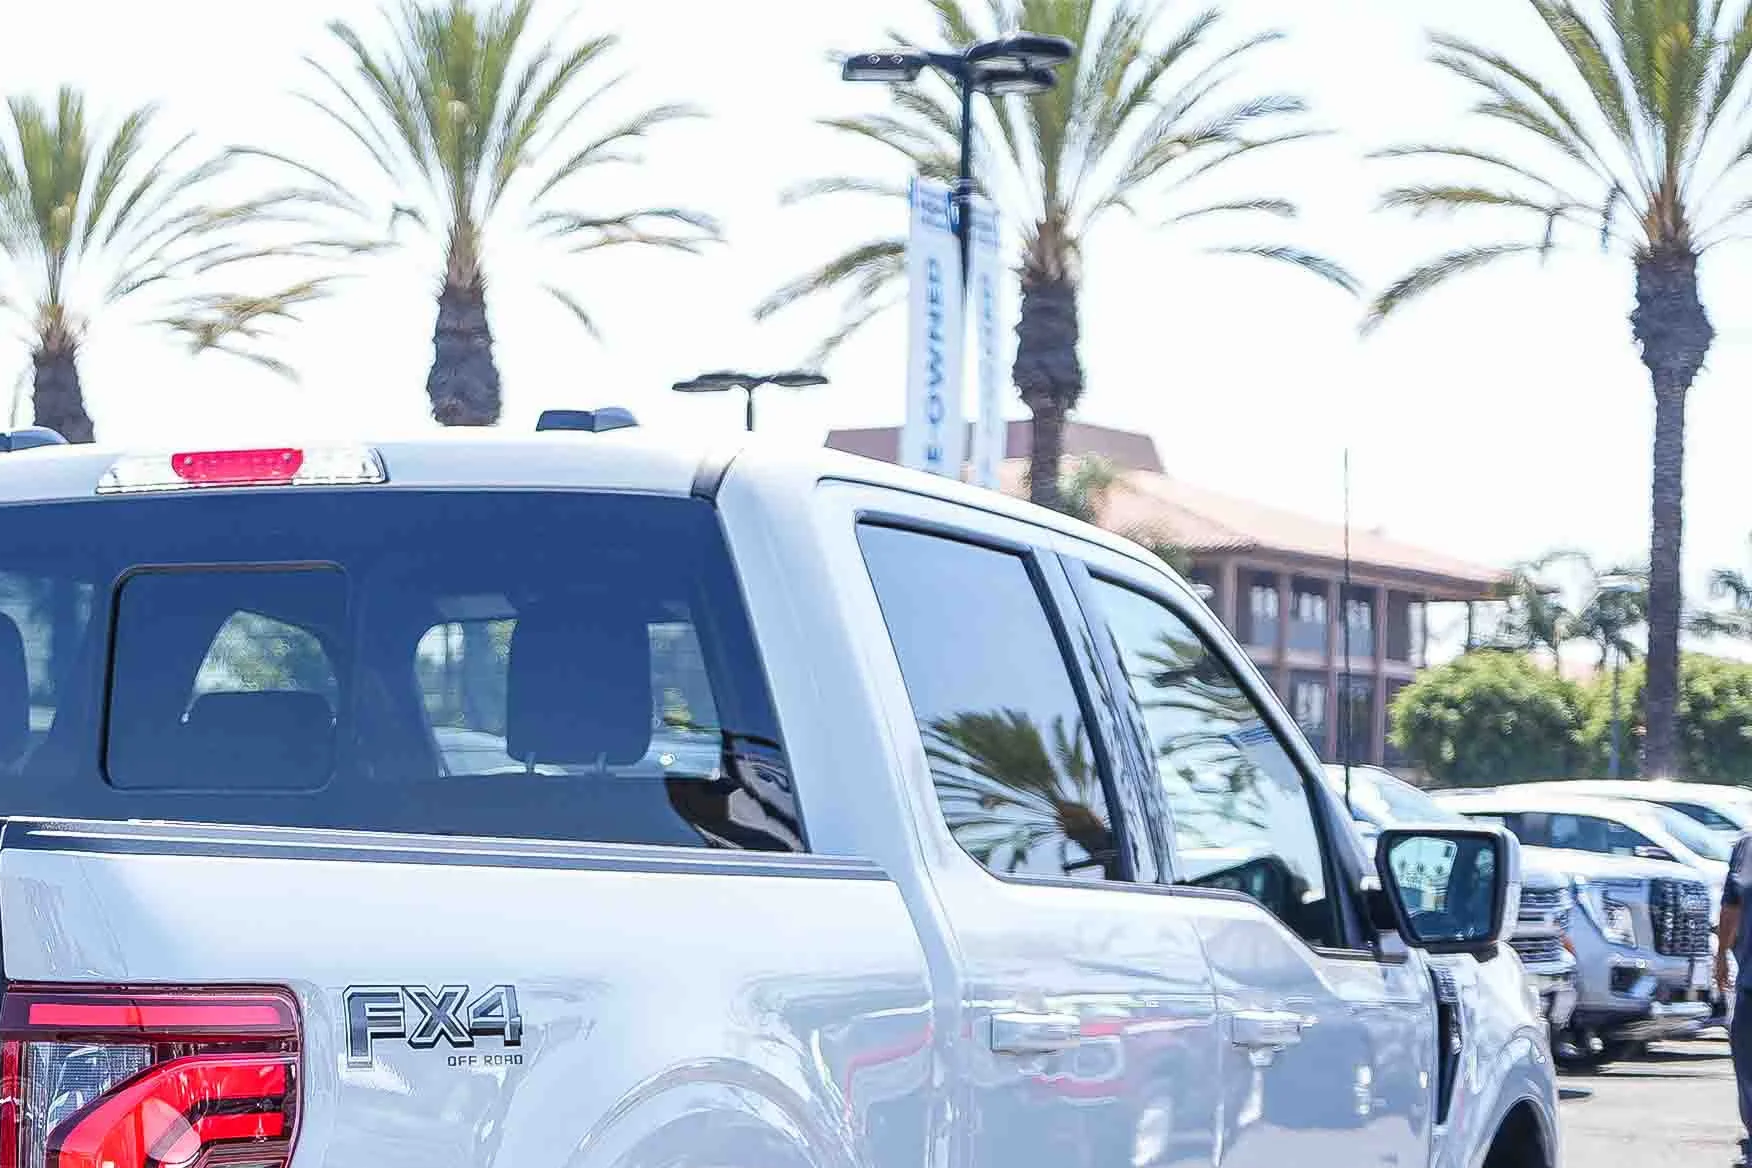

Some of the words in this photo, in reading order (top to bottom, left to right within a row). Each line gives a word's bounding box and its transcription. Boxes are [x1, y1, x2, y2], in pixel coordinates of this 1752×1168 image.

[343, 984, 524, 1069] FX4
[447, 1054, 478, 1067] OFF
[483, 1053, 524, 1066] ROAD
